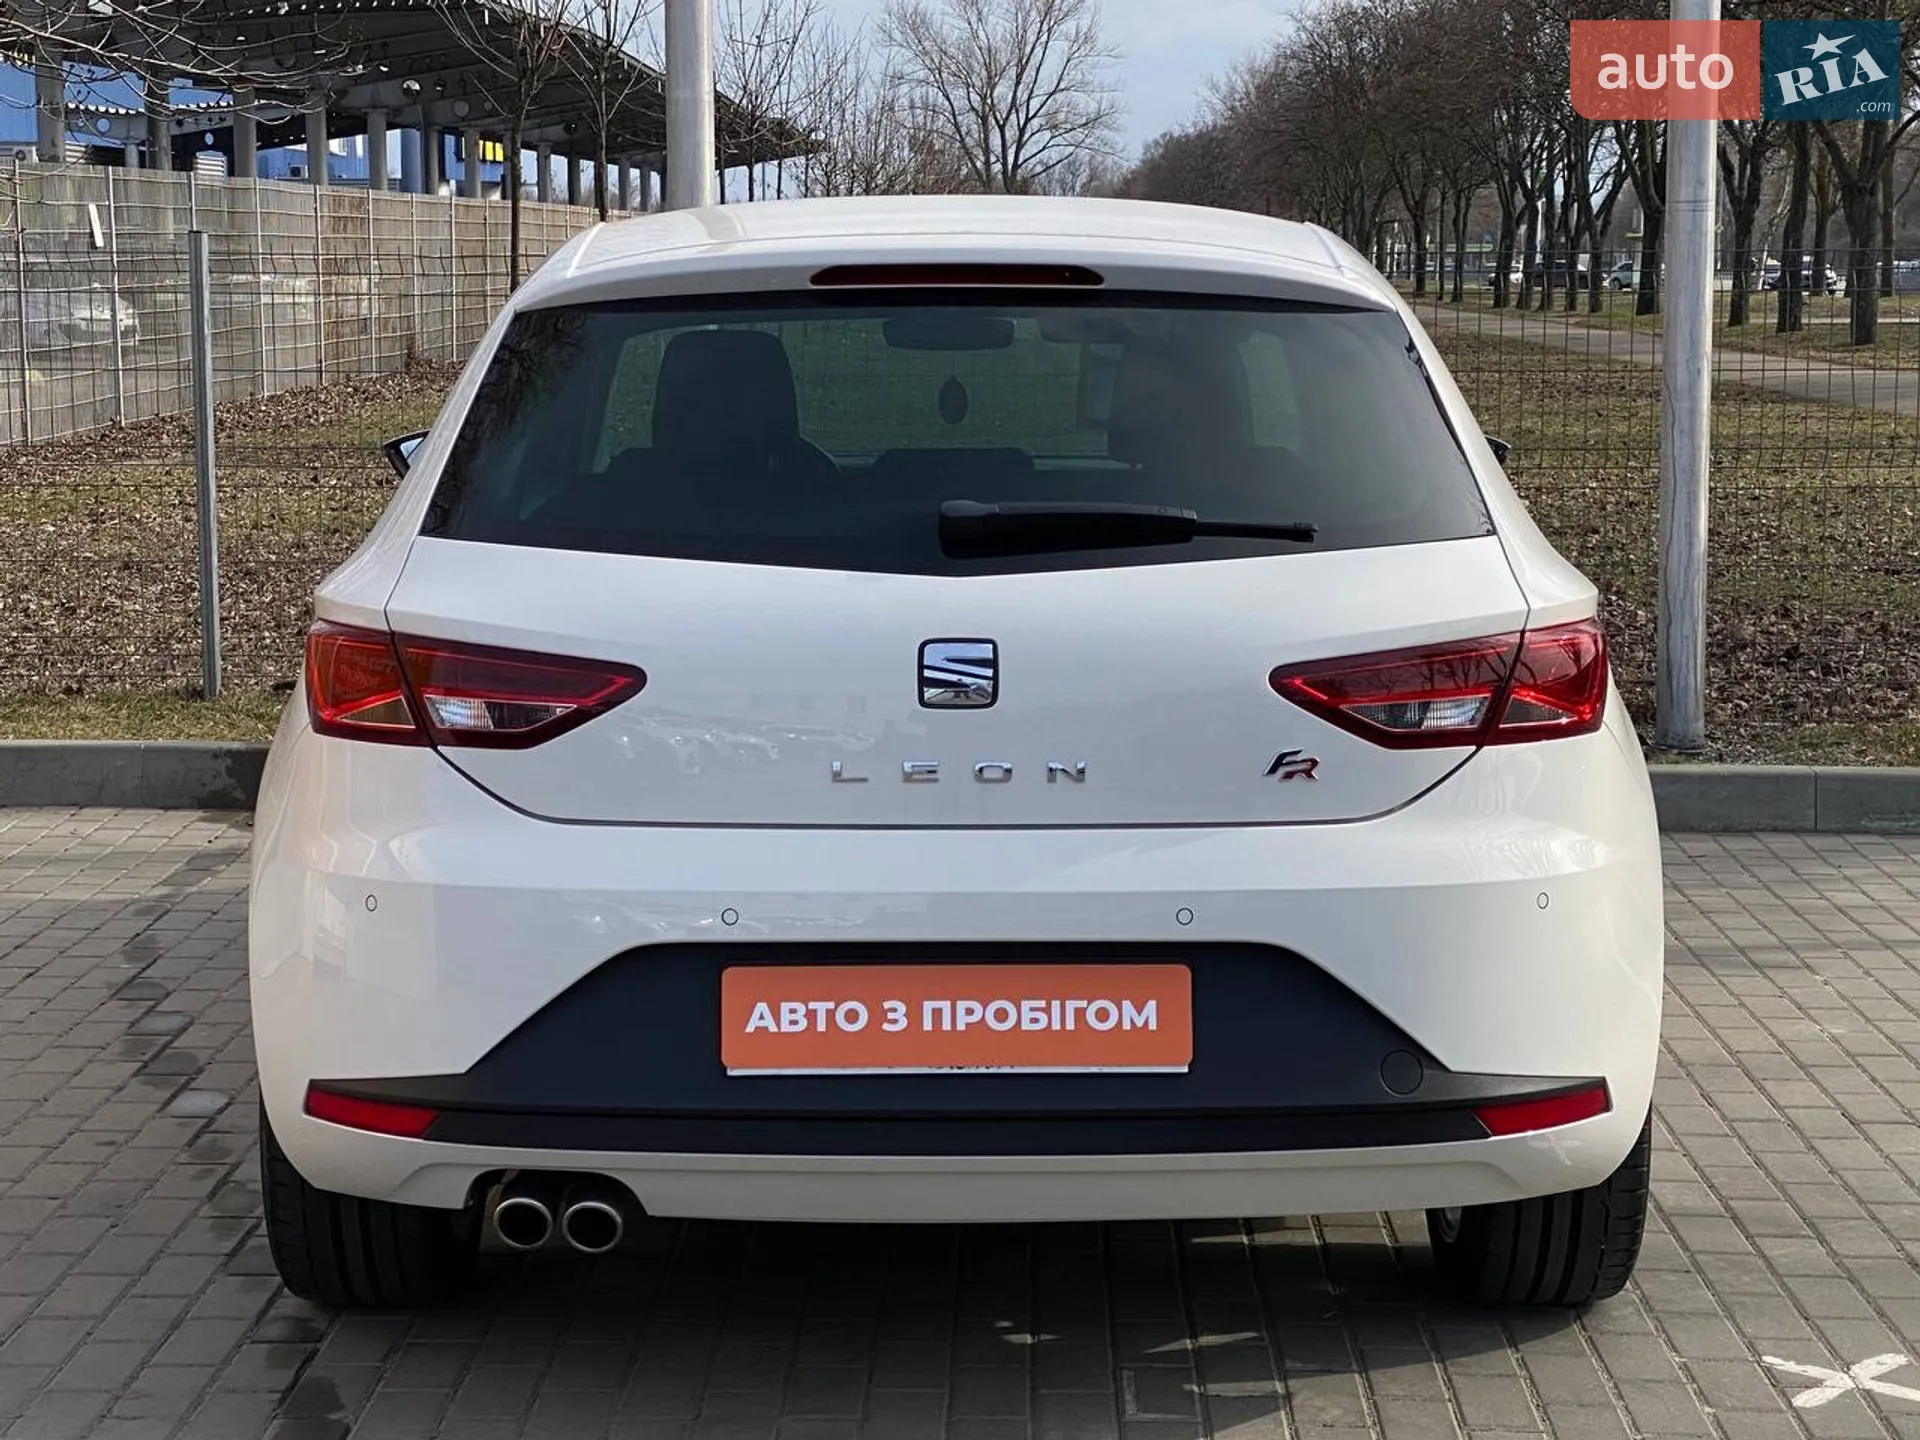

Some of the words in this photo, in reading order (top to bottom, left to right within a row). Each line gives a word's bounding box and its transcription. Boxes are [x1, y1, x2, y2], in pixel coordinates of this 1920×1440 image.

[830, 759, 1087, 783] LEON
[1262, 747, 1321, 783] FR
[744, 1000, 869, 1033] АВТО
[881, 1000, 908, 1032] З
[922, 999, 1158, 1032] ПРОБІГОМ
